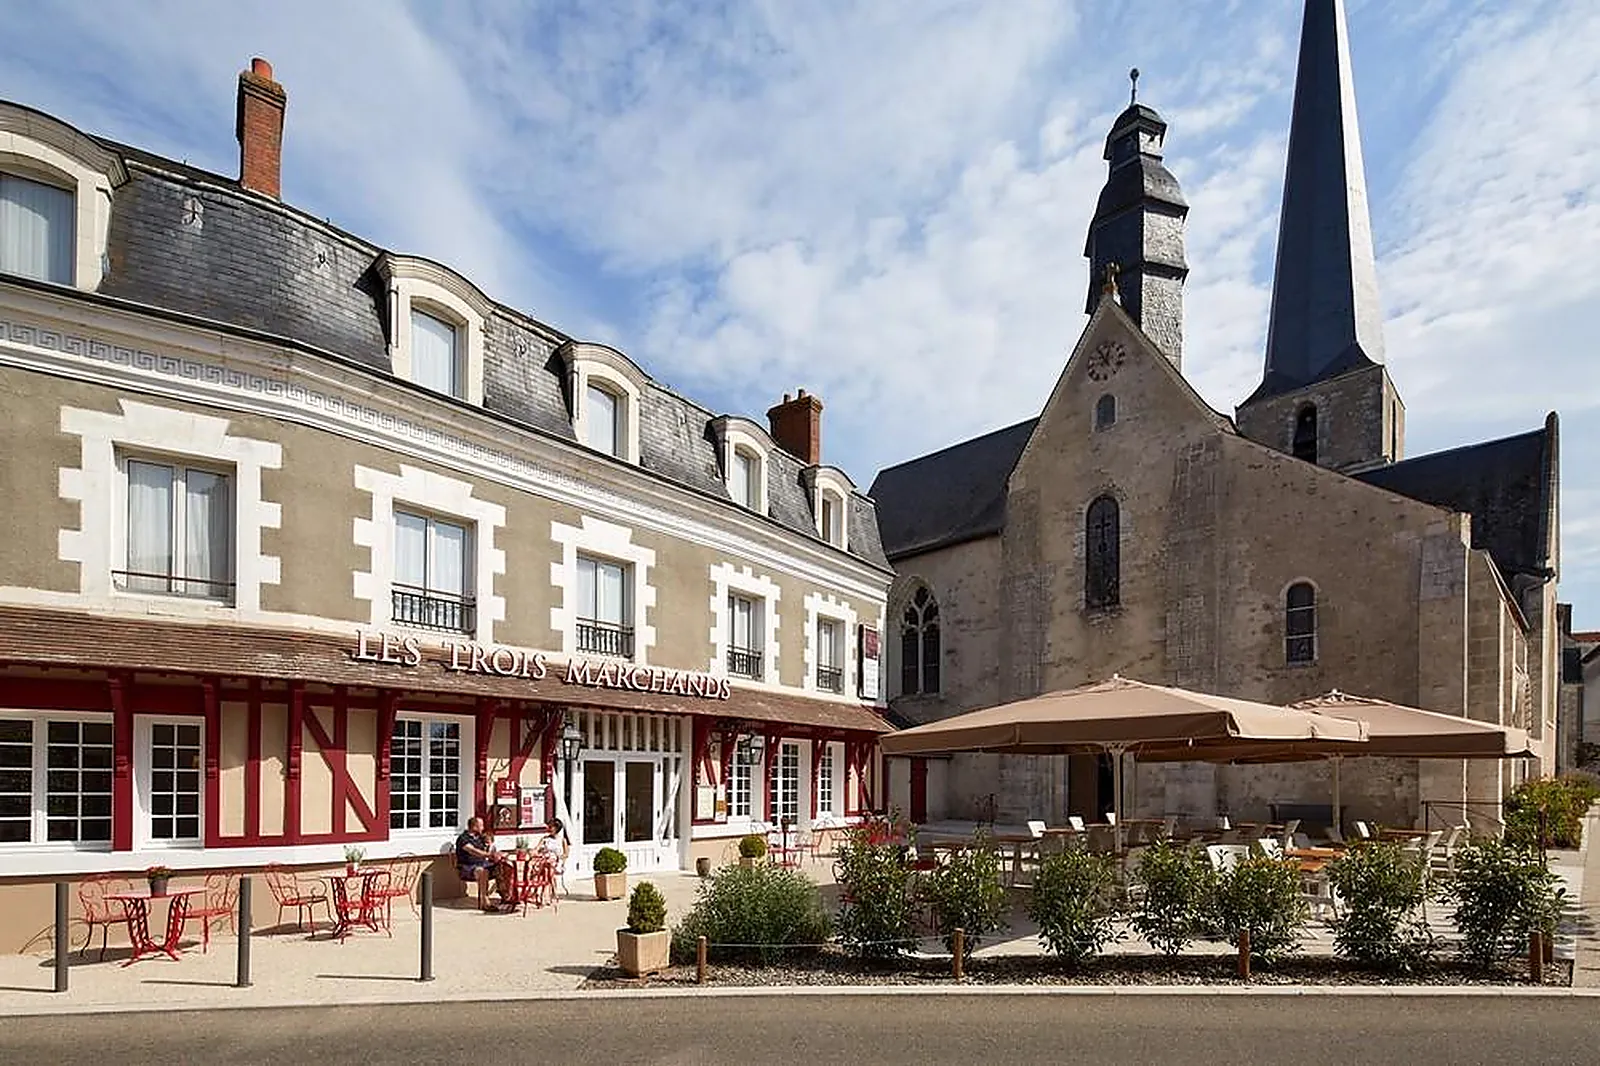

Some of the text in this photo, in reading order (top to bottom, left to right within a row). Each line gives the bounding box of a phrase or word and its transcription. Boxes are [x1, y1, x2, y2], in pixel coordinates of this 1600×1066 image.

[352, 629, 731, 700] LES TROIS MARCHANDS
